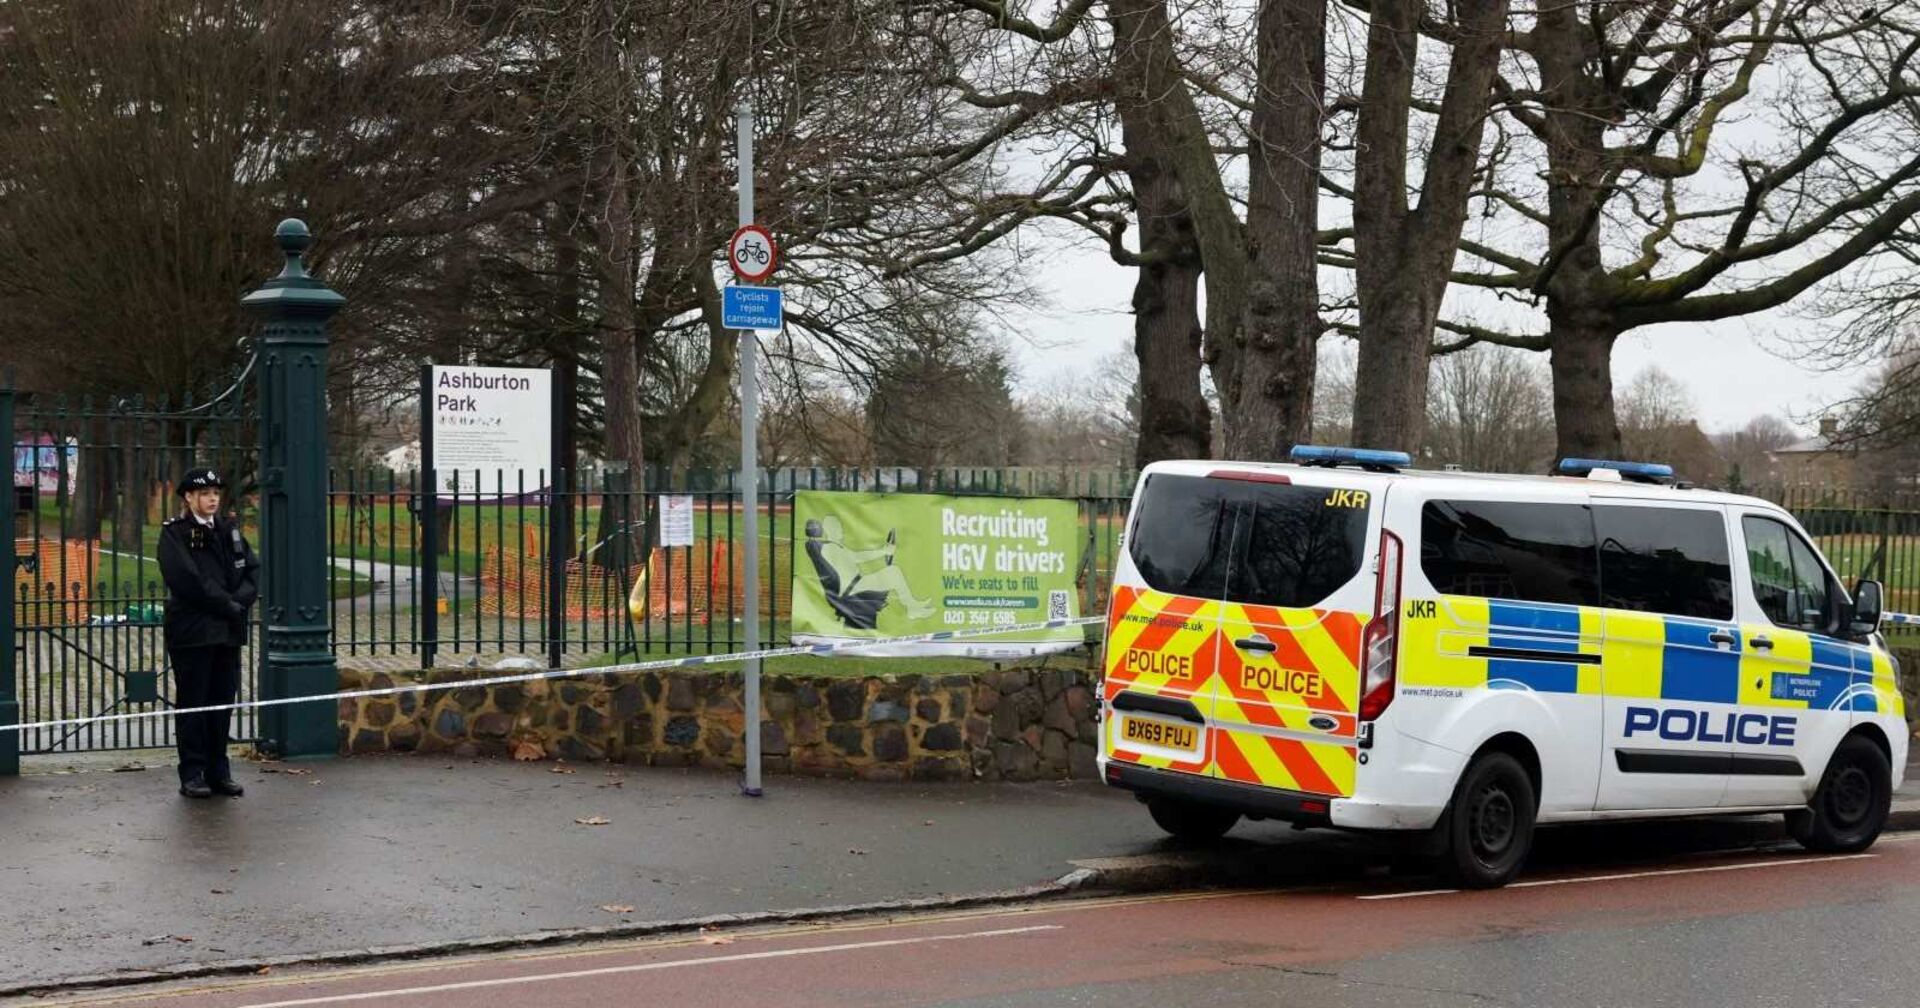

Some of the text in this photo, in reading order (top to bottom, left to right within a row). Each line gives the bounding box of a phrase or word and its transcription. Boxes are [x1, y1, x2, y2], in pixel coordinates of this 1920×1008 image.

[736, 290, 769, 303] Cyclists
[740, 304, 765, 315] rejoin
[726, 315, 778, 326] carriageway
[439, 371, 530, 390] Ashburton
[438, 394, 477, 412] Park
[1325, 489, 1368, 509] JKR
[942, 507, 1049, 546] Recruiting
[942, 542, 1065, 574] HGV drivers
[942, 575, 1039, 591] We've seats to fill
[943, 610, 965, 625] 020
[1407, 599, 1436, 619] JKR
[1128, 649, 1190, 677] POLICE
[1243, 665, 1320, 696] POLICE
[1401, 687, 1463, 699] www.met.police.uk
[1793, 687, 1817, 697] POLICE
[1128, 719, 1193, 747] BX69 FUJ
[1623, 706, 1798, 746] POLICE
